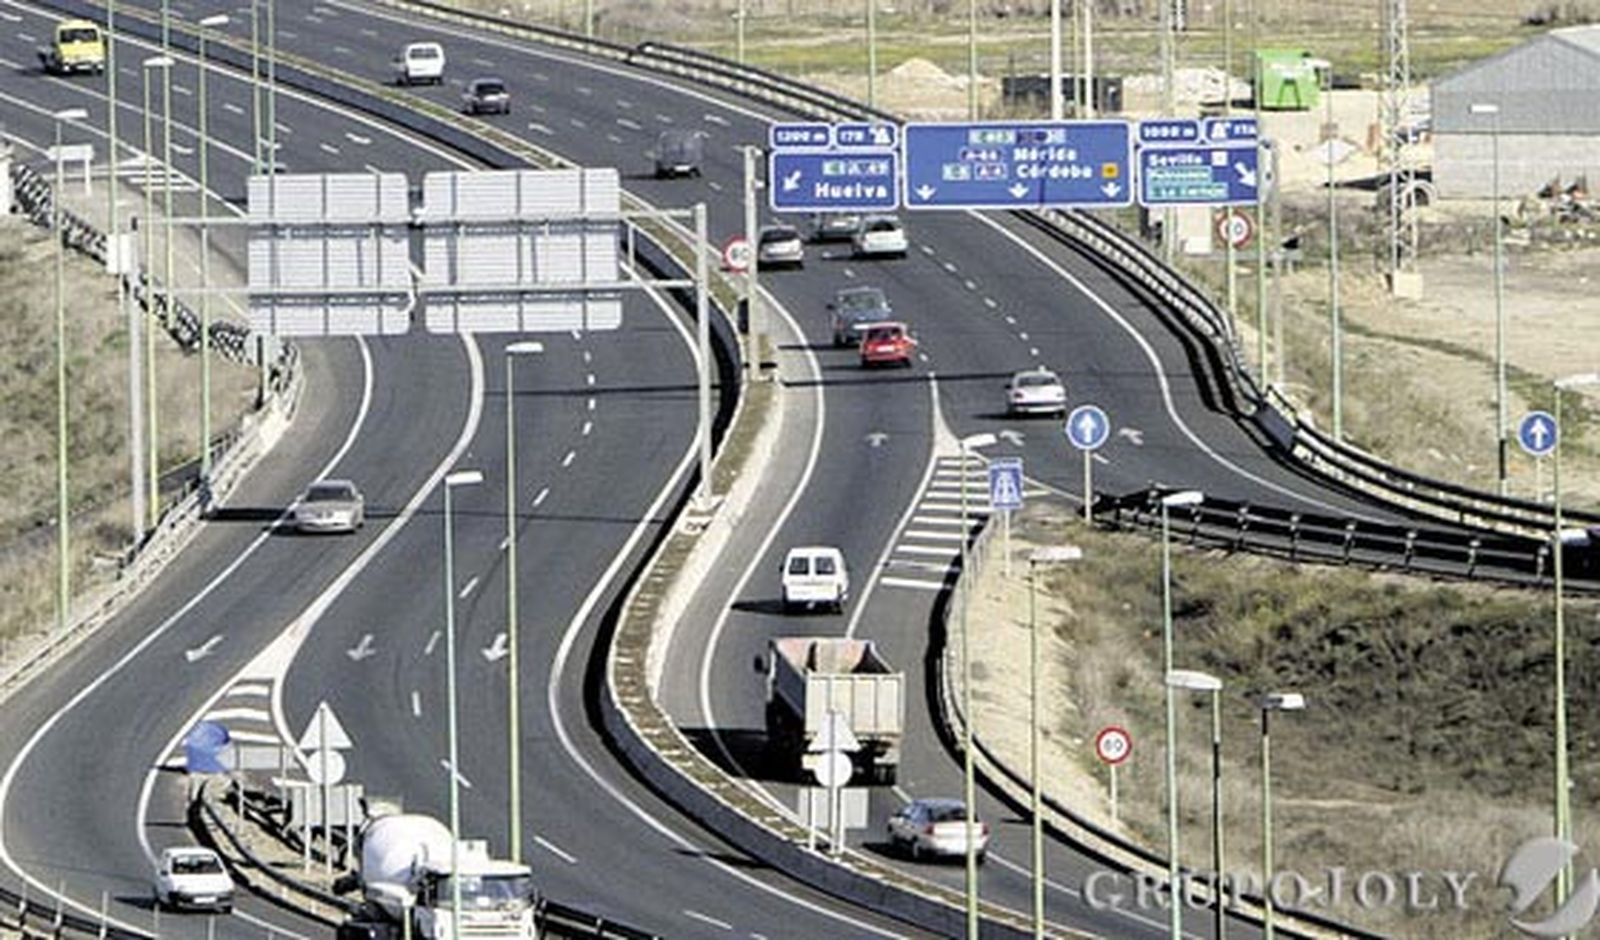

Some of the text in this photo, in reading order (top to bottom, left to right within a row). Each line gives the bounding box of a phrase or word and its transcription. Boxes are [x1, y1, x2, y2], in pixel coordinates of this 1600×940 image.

[1013, 146, 1077, 161] Mérida
[1149, 153, 1203, 167] Sevilla
[1016, 163, 1093, 179] Córdoba
[815, 182, 887, 198] Huelva
